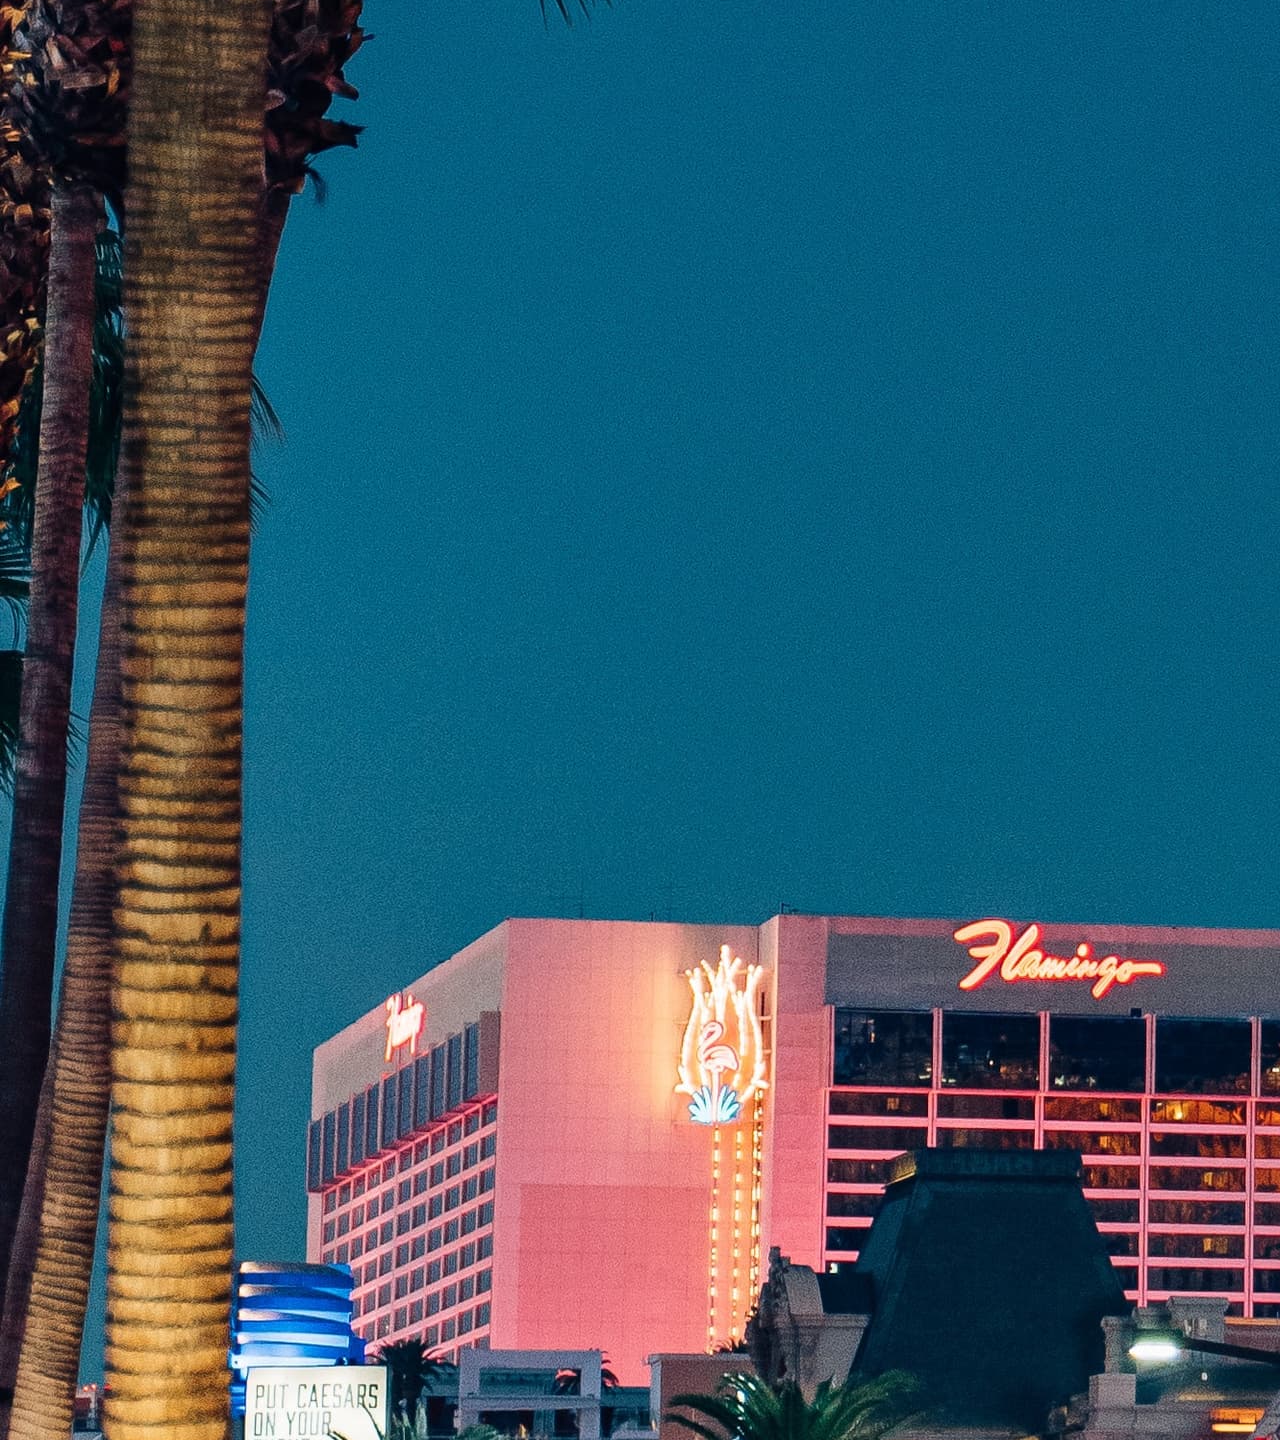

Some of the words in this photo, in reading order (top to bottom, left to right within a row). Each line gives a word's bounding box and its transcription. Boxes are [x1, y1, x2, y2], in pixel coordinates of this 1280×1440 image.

[954, 919, 1163, 999] Flamingo
[255, 1384, 288, 1408] PUT
[297, 1383, 379, 1409] CAESARS
[253, 1412, 275, 1437] ON
[286, 1411, 332, 1436] YOUR
